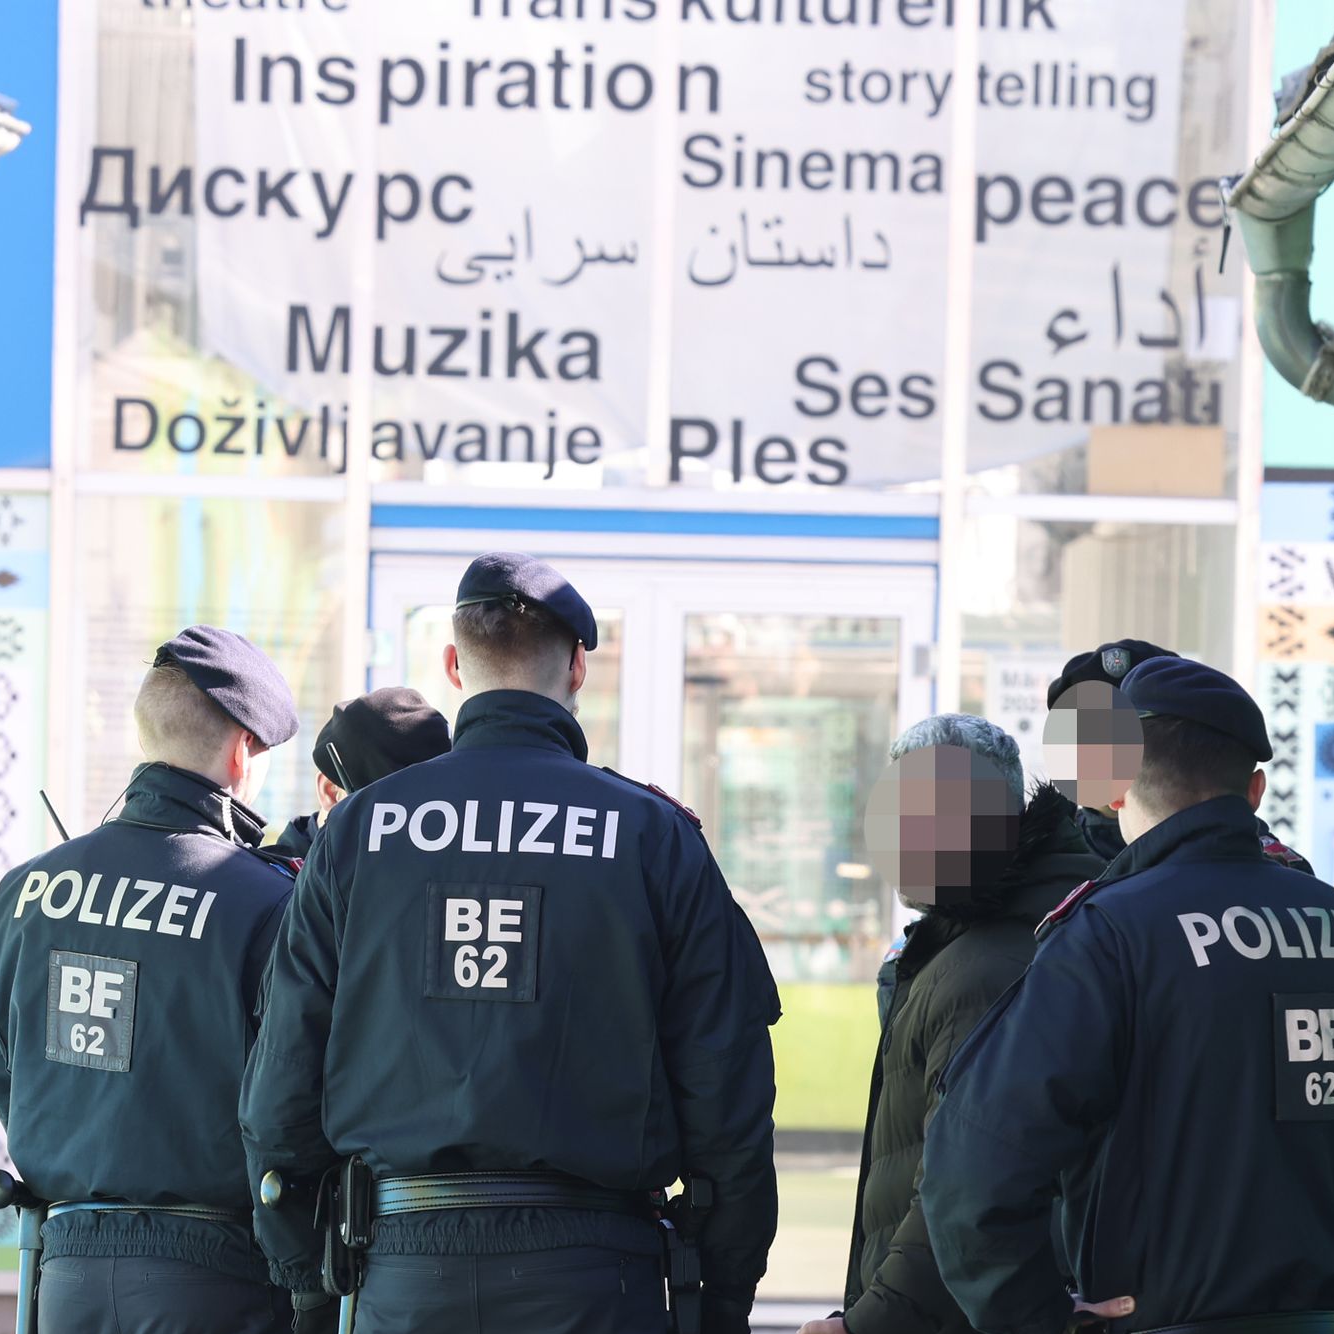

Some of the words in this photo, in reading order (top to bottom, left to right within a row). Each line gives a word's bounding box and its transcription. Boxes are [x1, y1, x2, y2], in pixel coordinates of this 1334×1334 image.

[231, 37, 721, 125] Inspiration
[78, 146, 475, 241] Дискурс
[681, 132, 944, 195] Sinema
[975, 173, 1223, 243] peace
[286, 304, 602, 382] Muzika
[792, 355, 938, 421] Ses
[668, 415, 849, 486] Ples
[367, 799, 620, 859] POLIZEI
[13, 869, 218, 940] POLIZEI
[444, 897, 524, 943] BE
[58, 965, 125, 1020] BE
[453, 944, 509, 989] 62
[69, 1022, 106, 1057] 62
